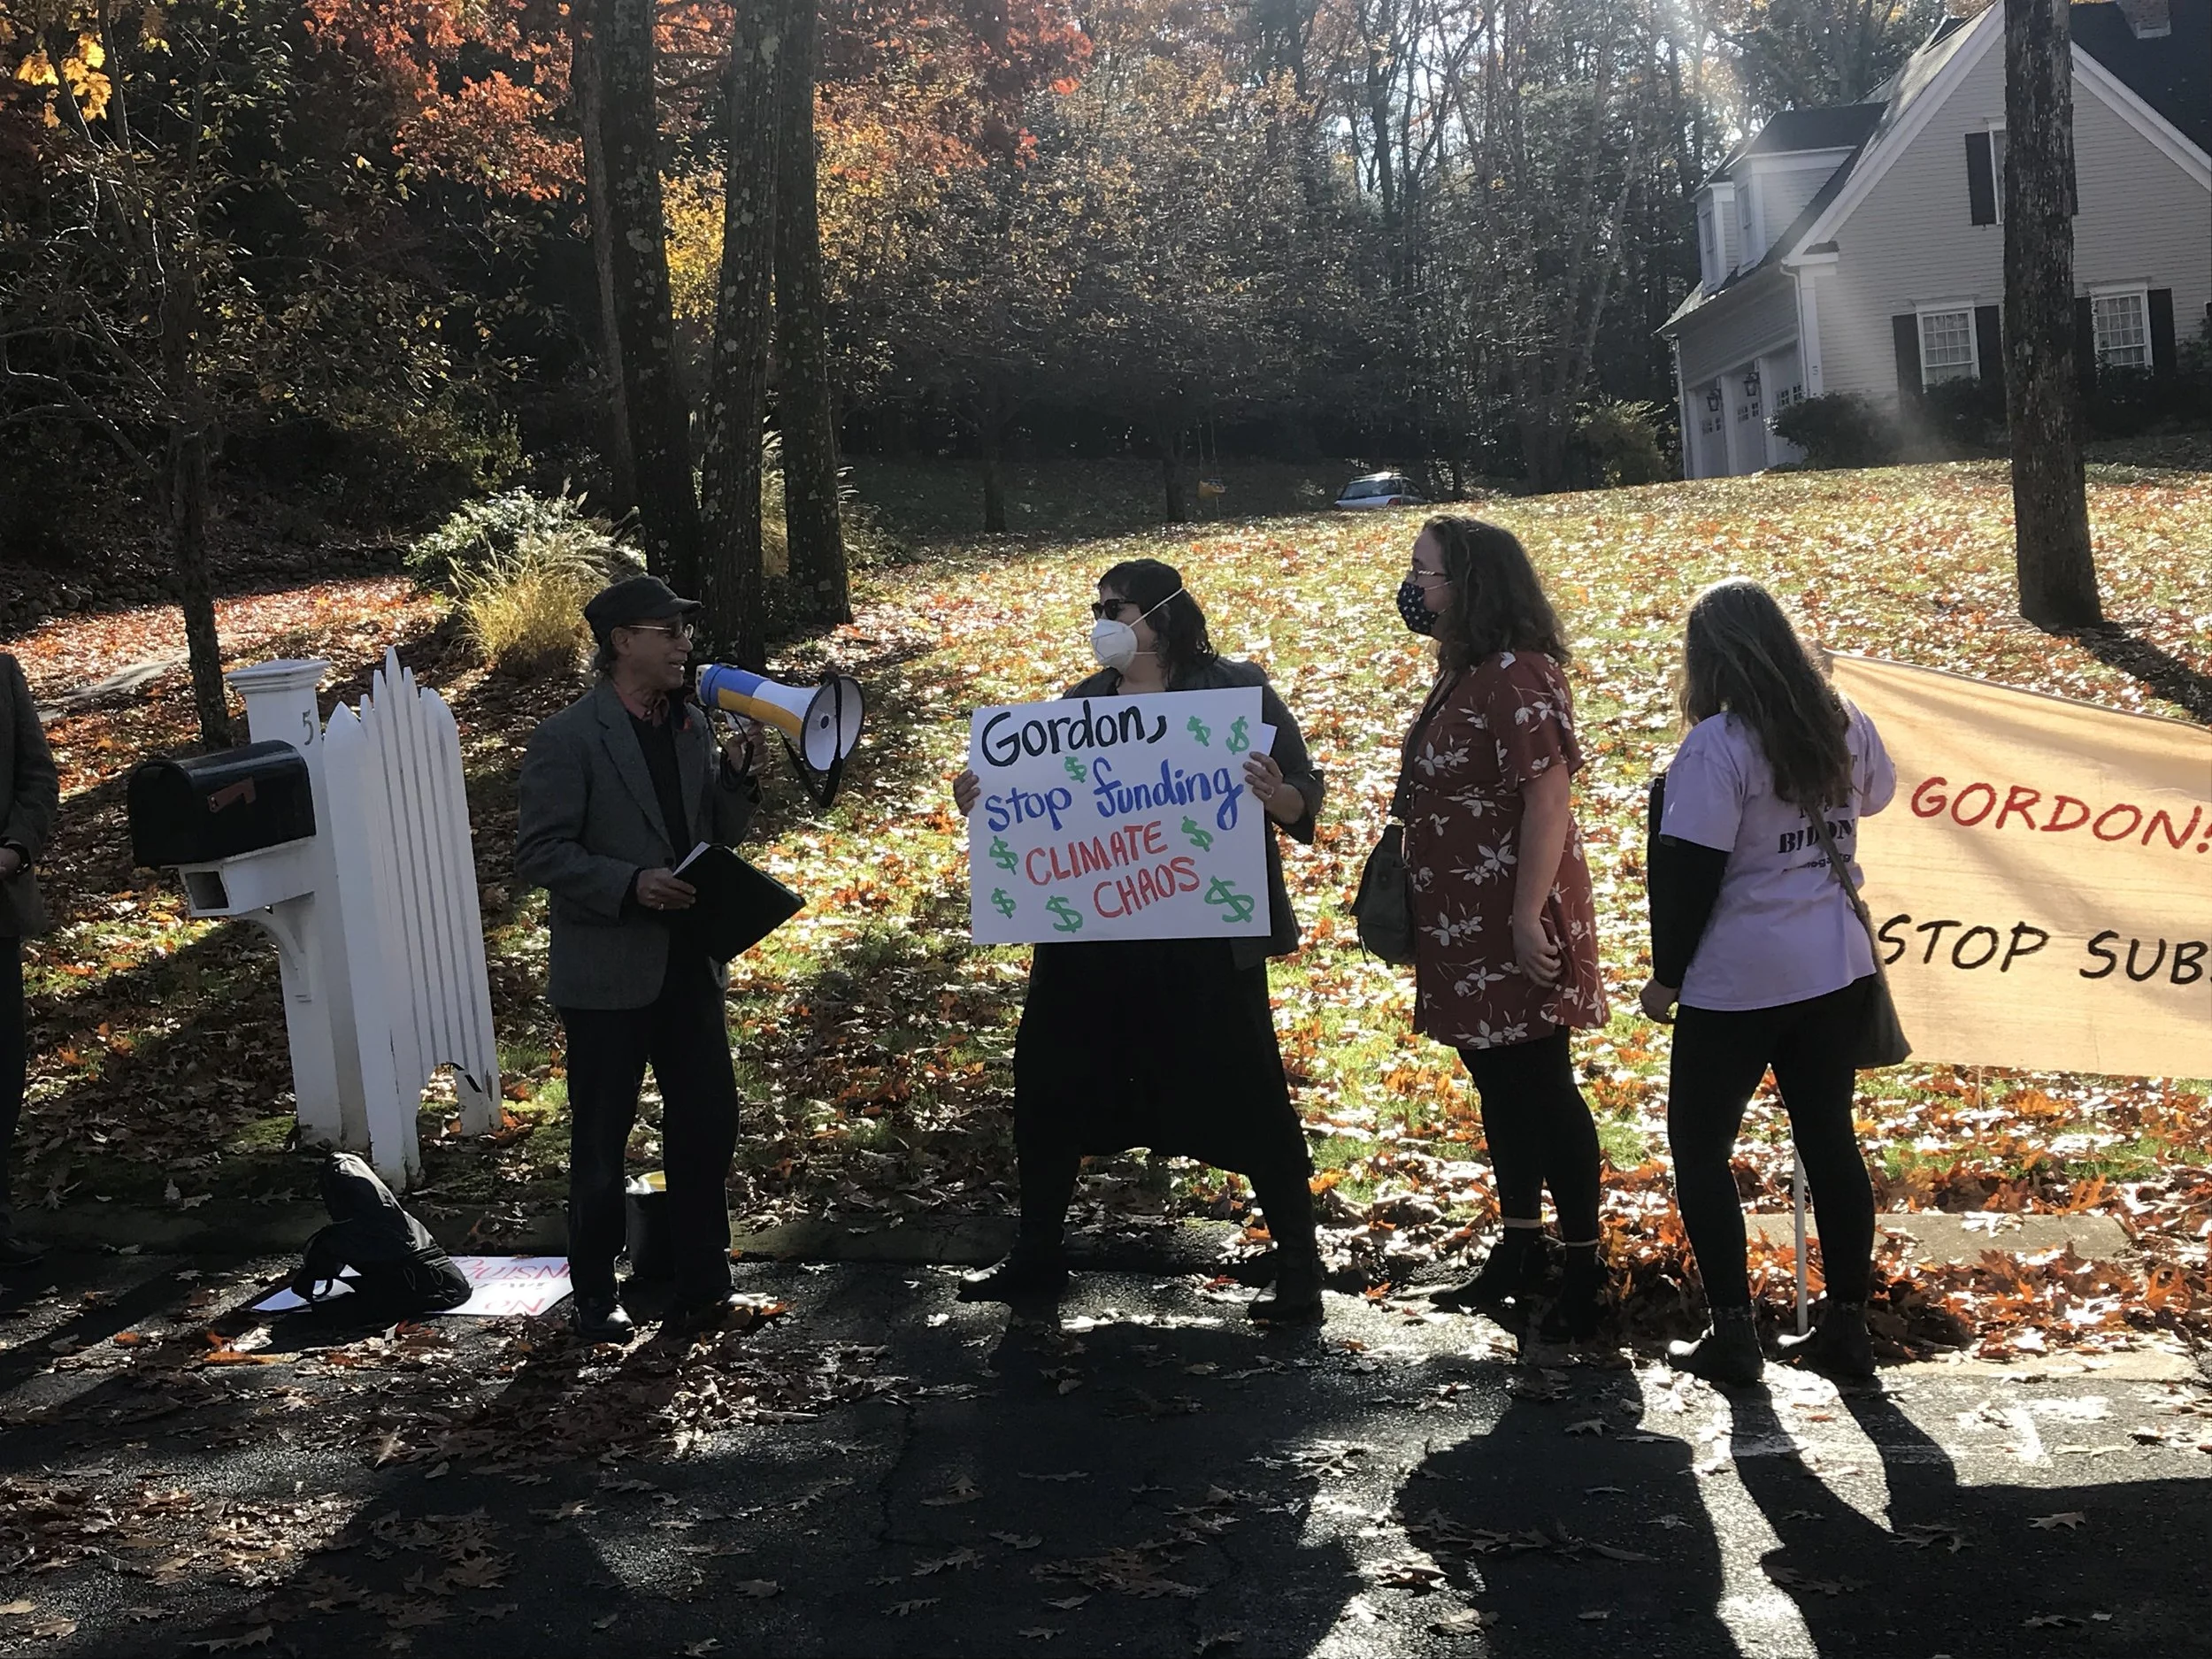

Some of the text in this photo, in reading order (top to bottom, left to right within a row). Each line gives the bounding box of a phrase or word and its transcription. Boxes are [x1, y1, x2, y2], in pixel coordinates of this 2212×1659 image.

[302, 709, 314, 746] 5
[981, 699, 1167, 767] Gordon,
[1093, 757, 1244, 831] funding
[1025, 820, 1169, 886] CLIMATE
[1094, 856, 1201, 918] CHAOS
[1878, 913, 2212, 985] STOP SUB
